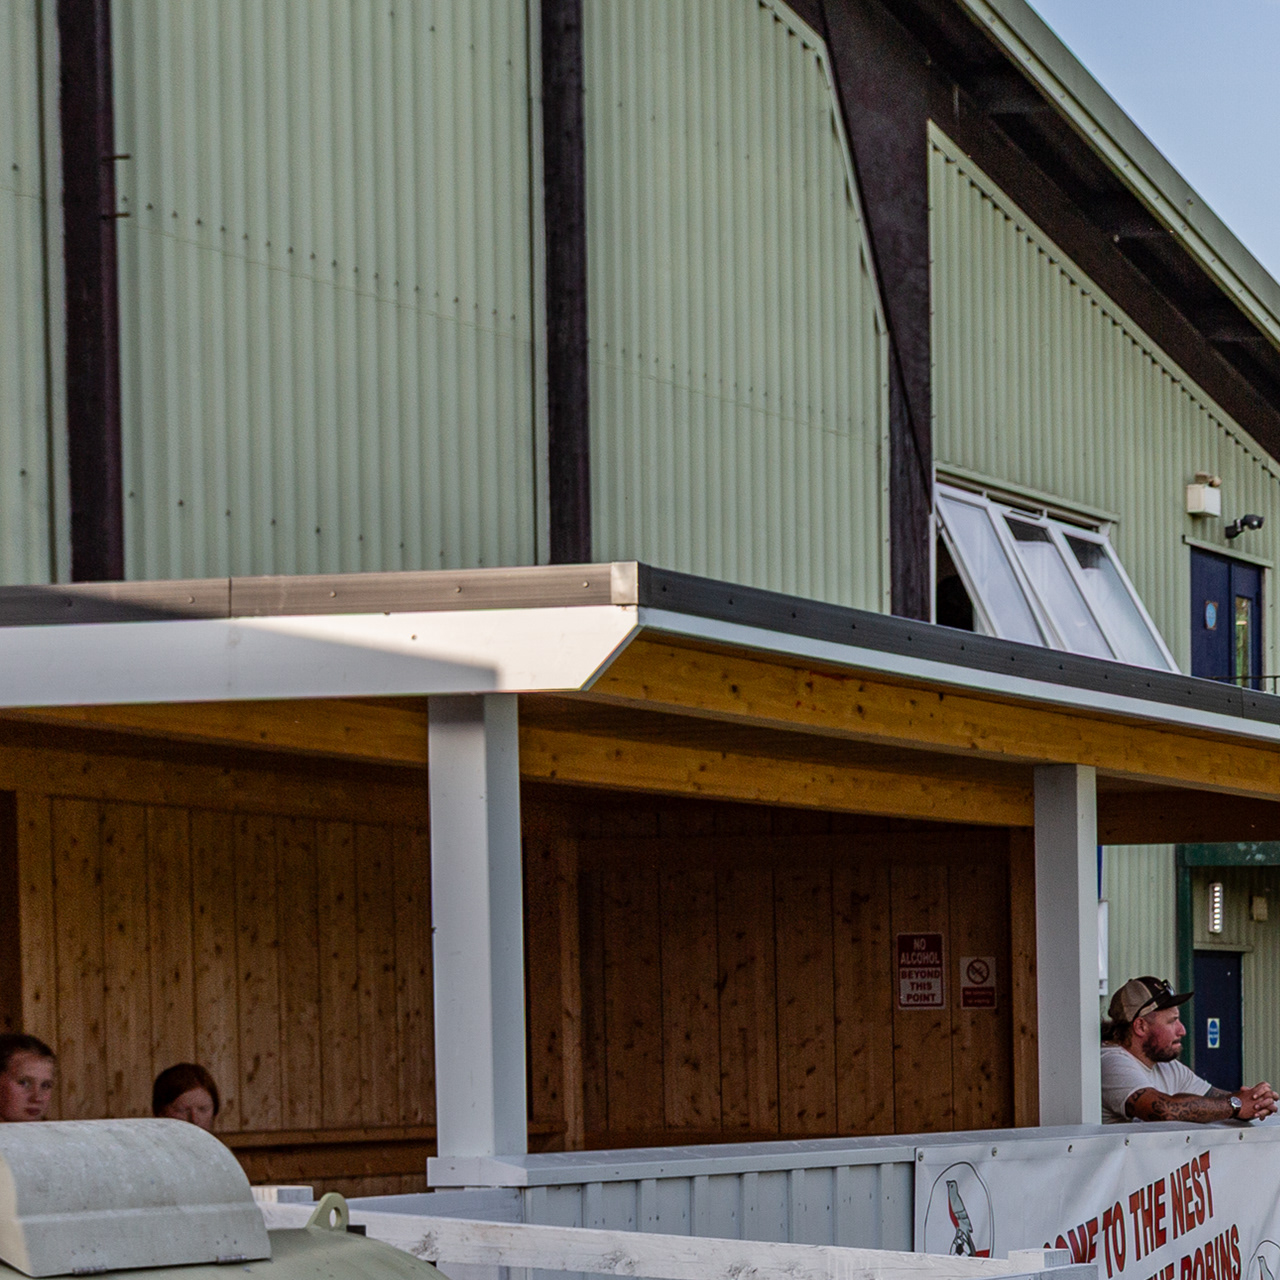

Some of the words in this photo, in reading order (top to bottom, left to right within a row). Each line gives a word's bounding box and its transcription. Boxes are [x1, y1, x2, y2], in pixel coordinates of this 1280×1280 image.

[913, 937, 926, 950] NO
[900, 951, 940, 964] ALCOHOL
[901, 970, 940, 979] BEYOND
[910, 981, 932, 991] THIS
[906, 993, 935, 1002] POINT
[1102, 1201, 1126, 1279] TO
[1129, 1177, 1167, 1261] THE
[1170, 1150, 1214, 1240] NEST
